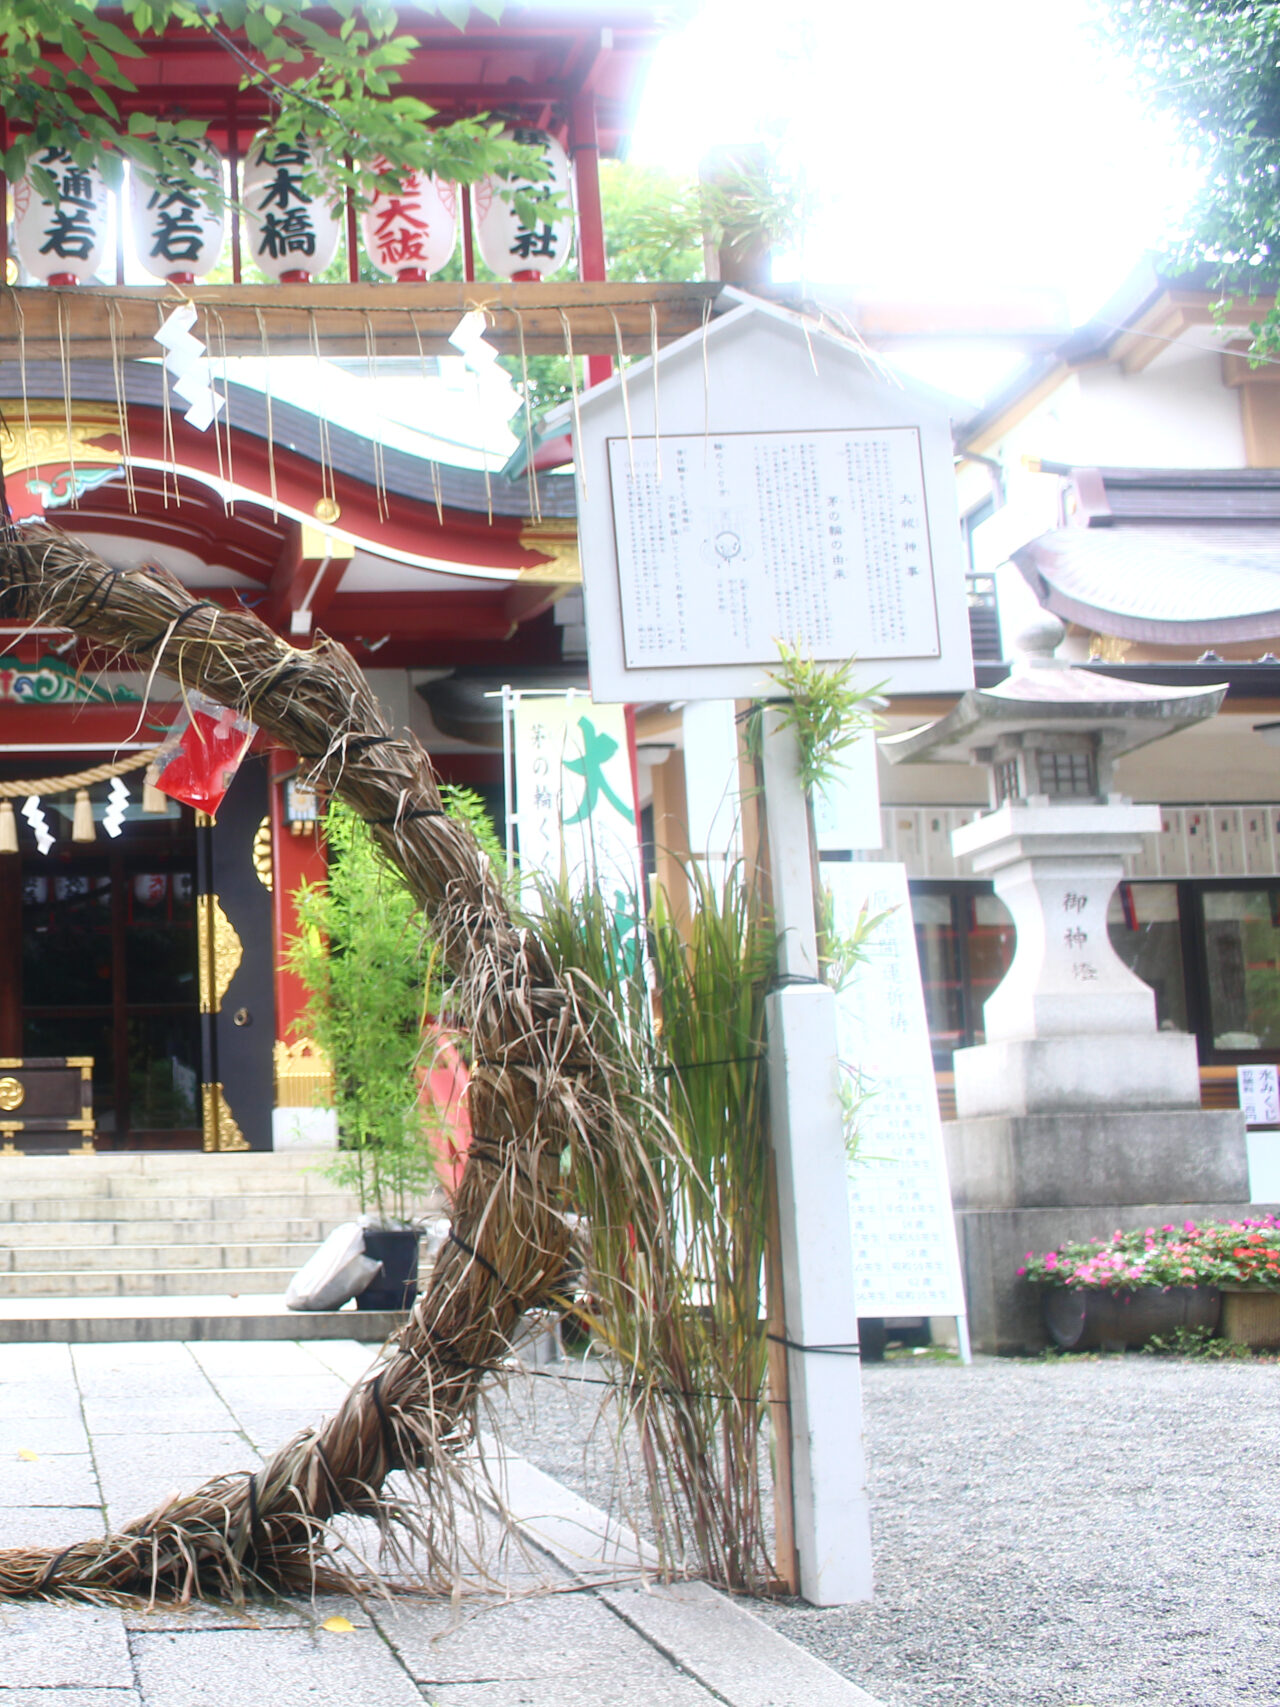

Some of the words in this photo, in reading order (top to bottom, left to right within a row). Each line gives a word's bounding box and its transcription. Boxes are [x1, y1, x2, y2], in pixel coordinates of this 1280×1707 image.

[531, 723, 553, 876] 茅の輪くぐ
